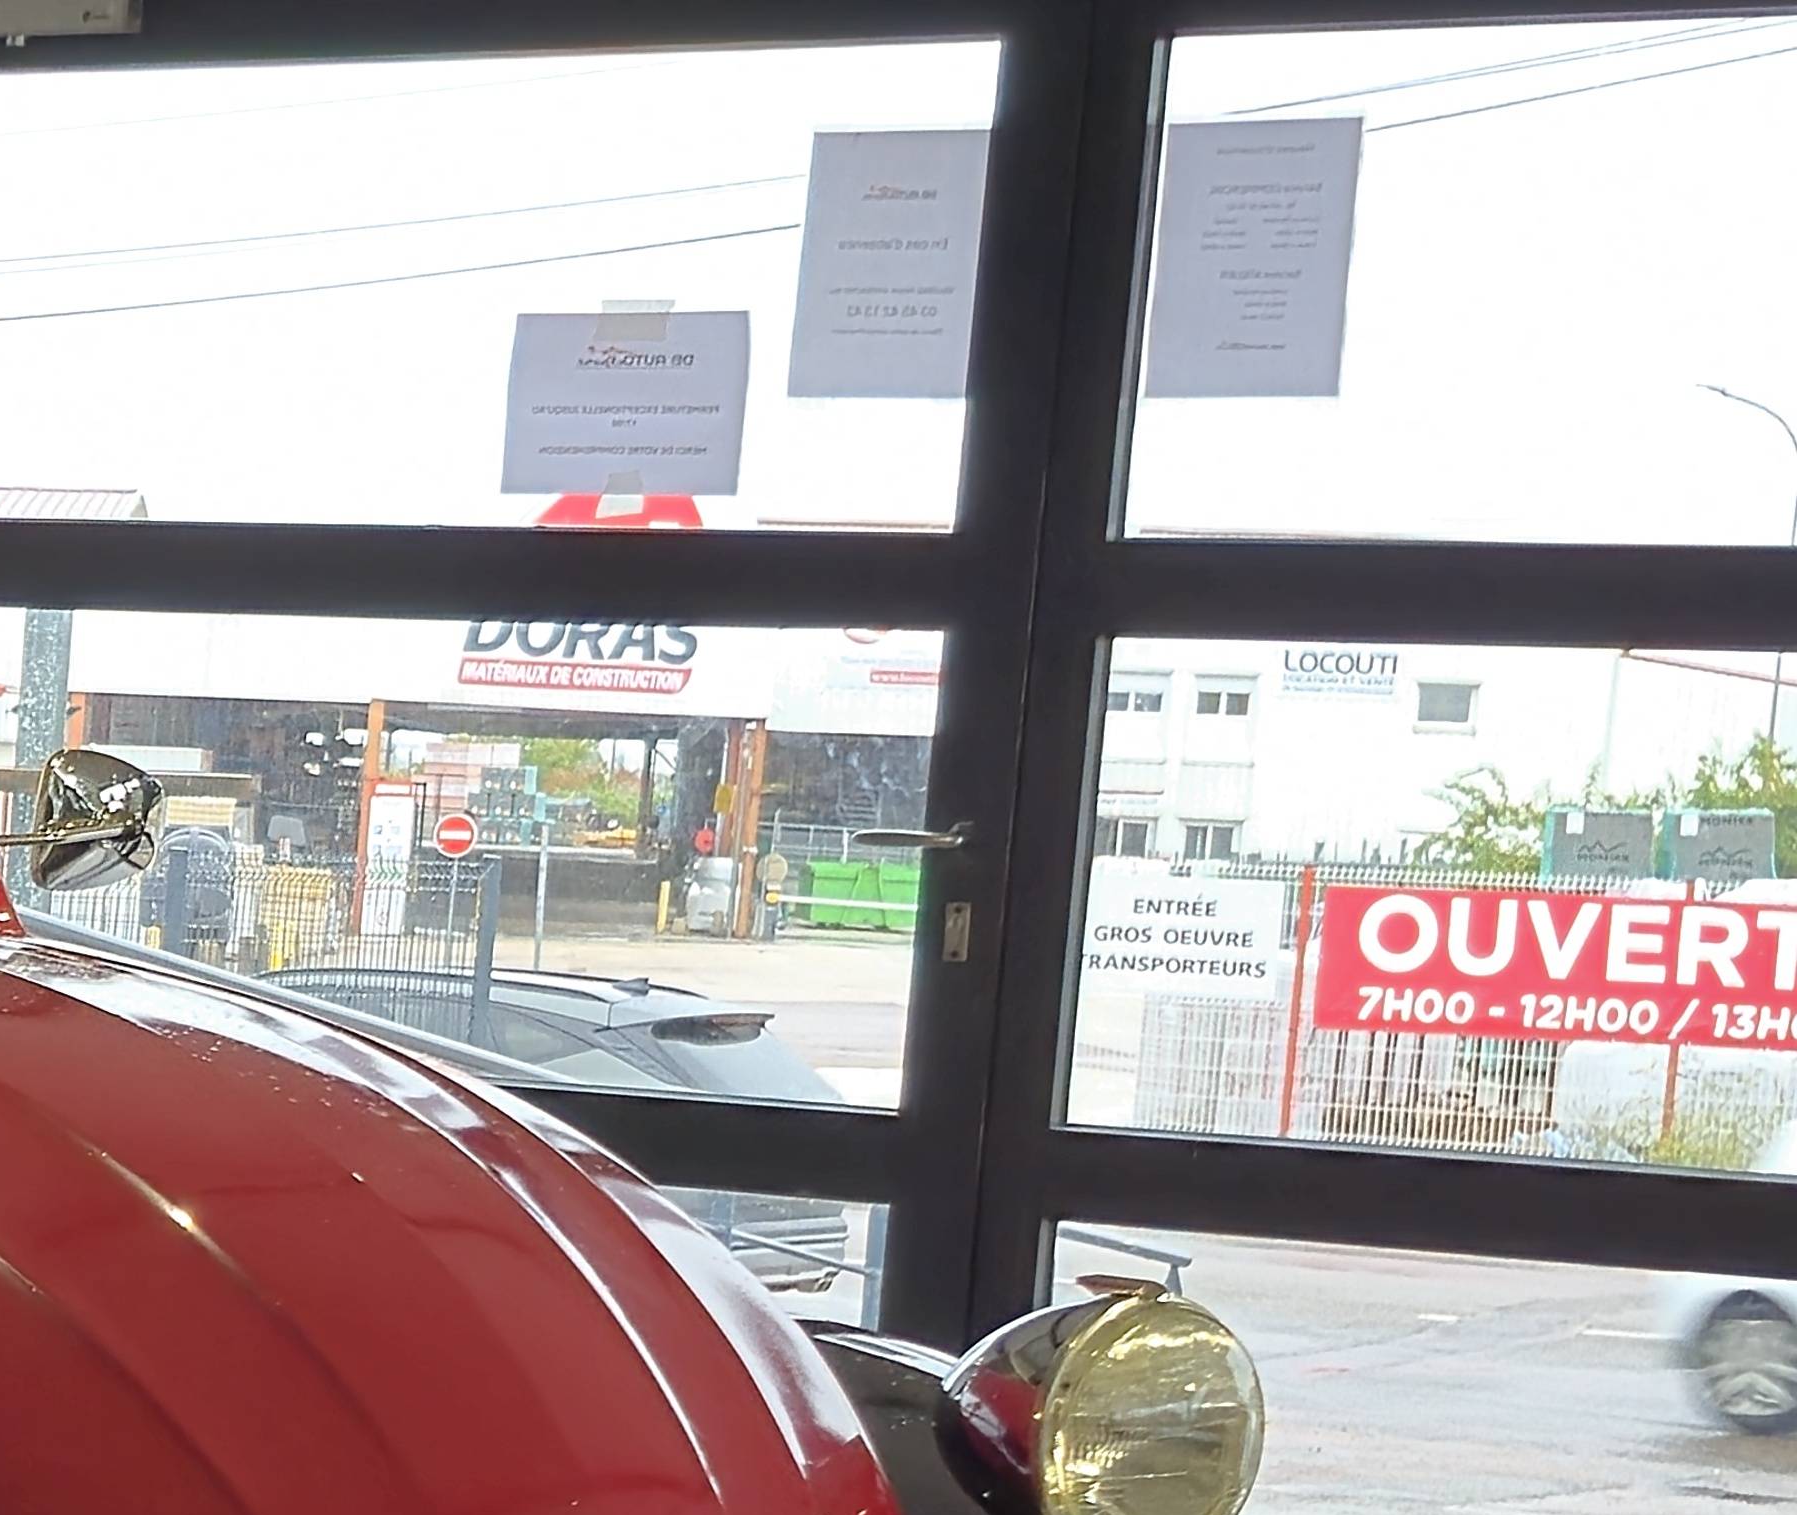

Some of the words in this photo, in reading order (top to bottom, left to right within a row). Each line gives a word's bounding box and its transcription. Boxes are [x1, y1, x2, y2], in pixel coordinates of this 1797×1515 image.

[1284, 648, 1398, 675] LOCOUTI
[550, 667, 572, 686] DE
[572, 668, 685, 691] CONSTRUCTION
[1132, 892, 1218, 917] ENTRÉE
[1093, 925, 1153, 943] GROS
[1163, 928, 1254, 948] OEUVRE
[1358, 893, 1797, 992] OUVERT
[1357, 986, 1475, 1024] 7H00
[1520, 993, 1660, 1034] 12H00
[1710, 1002, 1797, 1041] 13H
